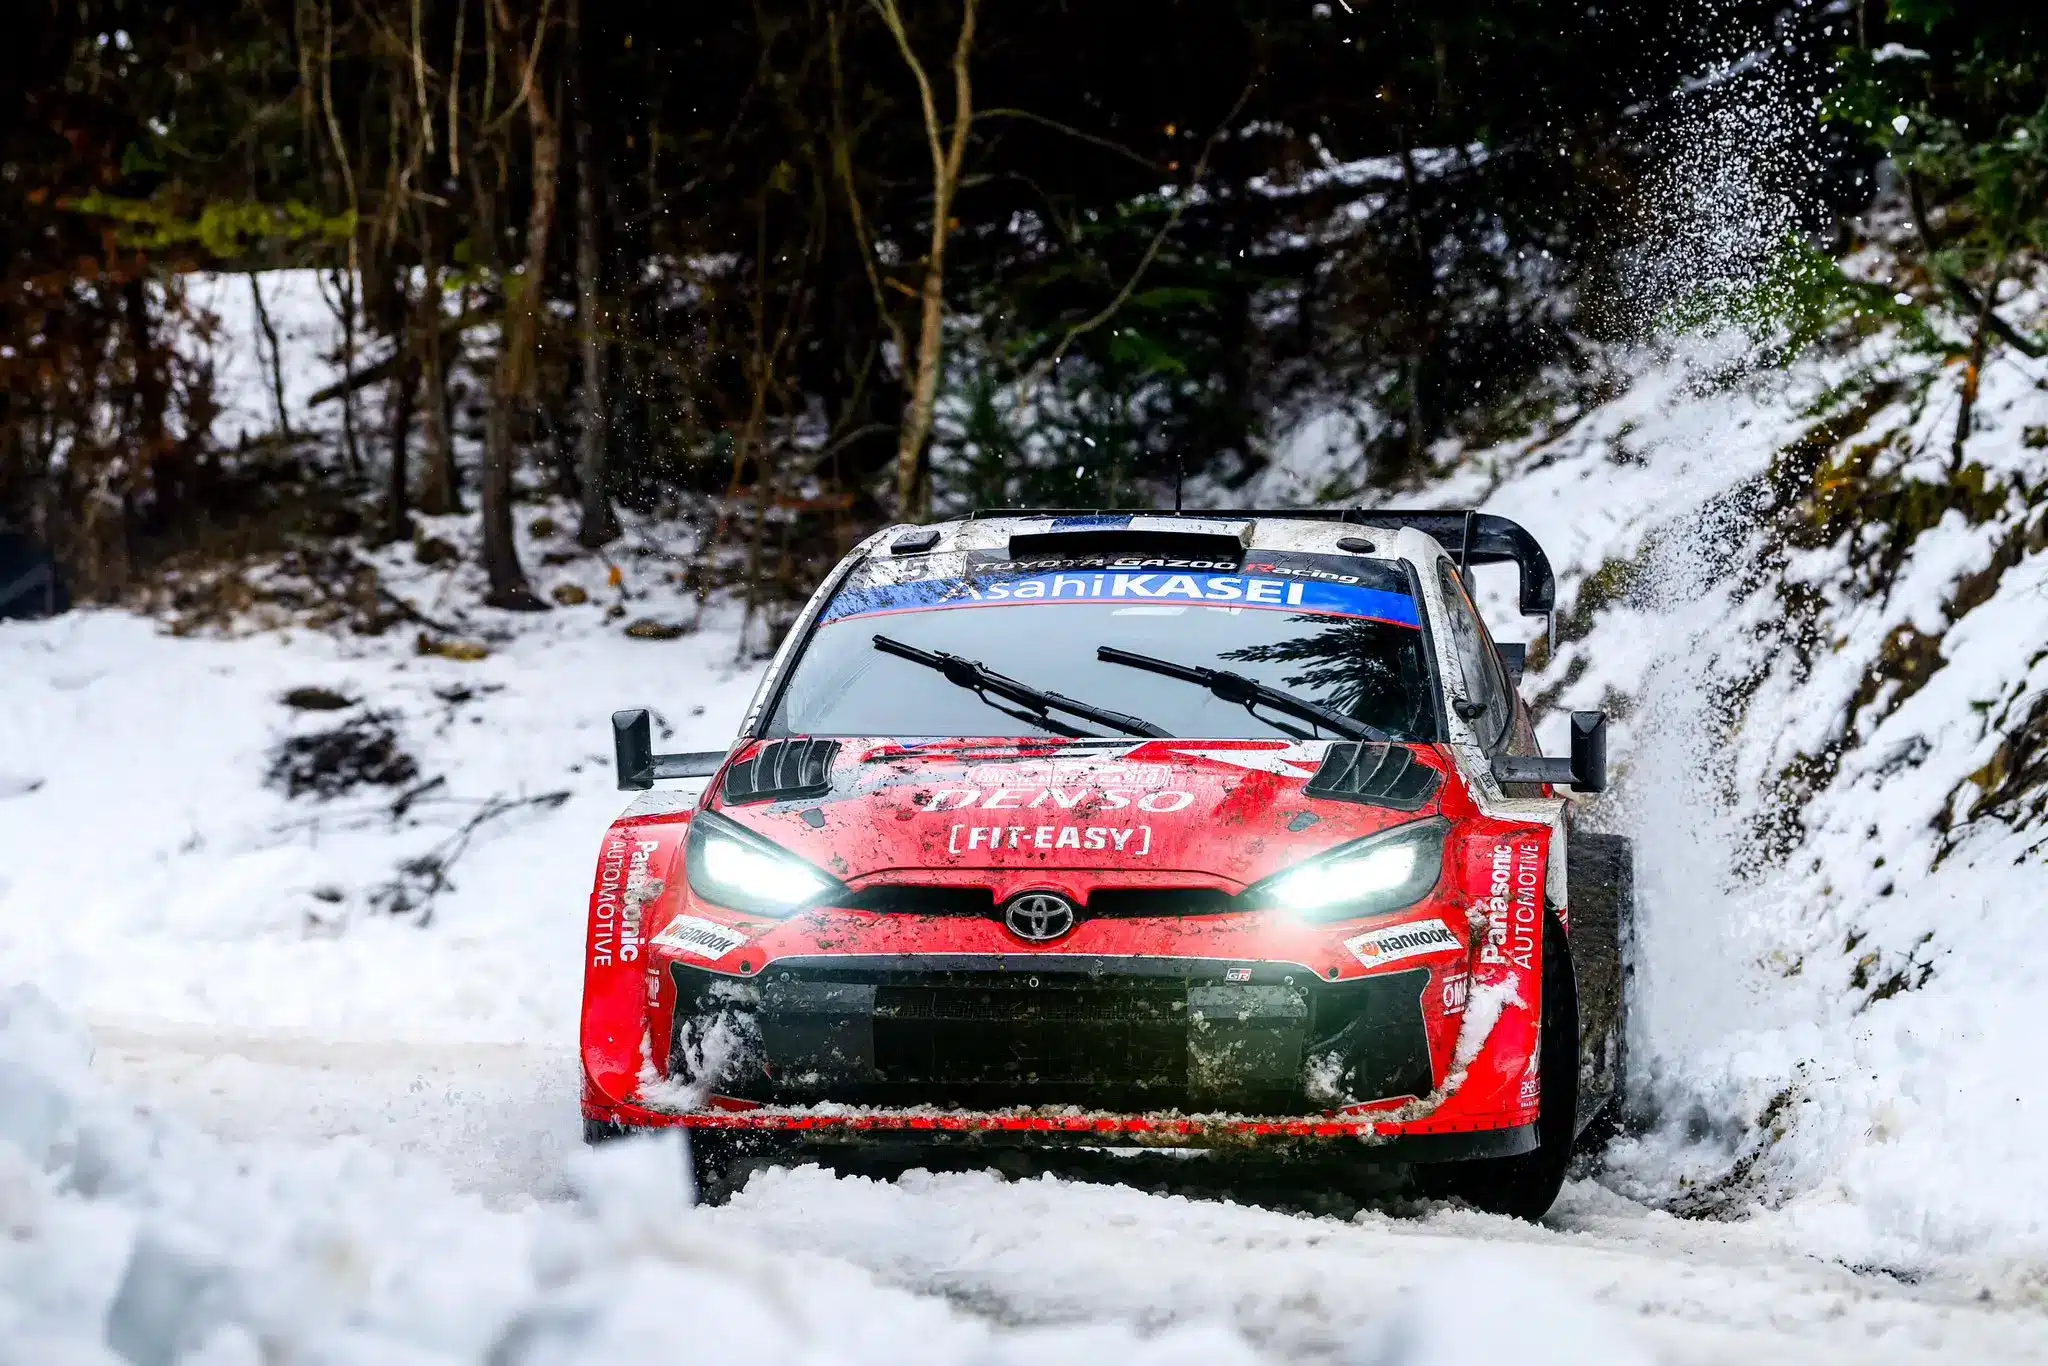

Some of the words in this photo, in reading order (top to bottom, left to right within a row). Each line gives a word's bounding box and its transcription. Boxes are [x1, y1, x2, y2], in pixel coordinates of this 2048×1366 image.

[1113, 557, 1238, 571] GAZOO
[1243, 562, 1360, 584] Racing
[921, 788, 1196, 813] DENSO
[594, 841, 629, 968] AUTOMOTIVE
[619, 841, 659, 962] Panaonic
[1480, 845, 1513, 965] Panasonic
[1513, 844, 1539, 970] AUTOMOTIVE
